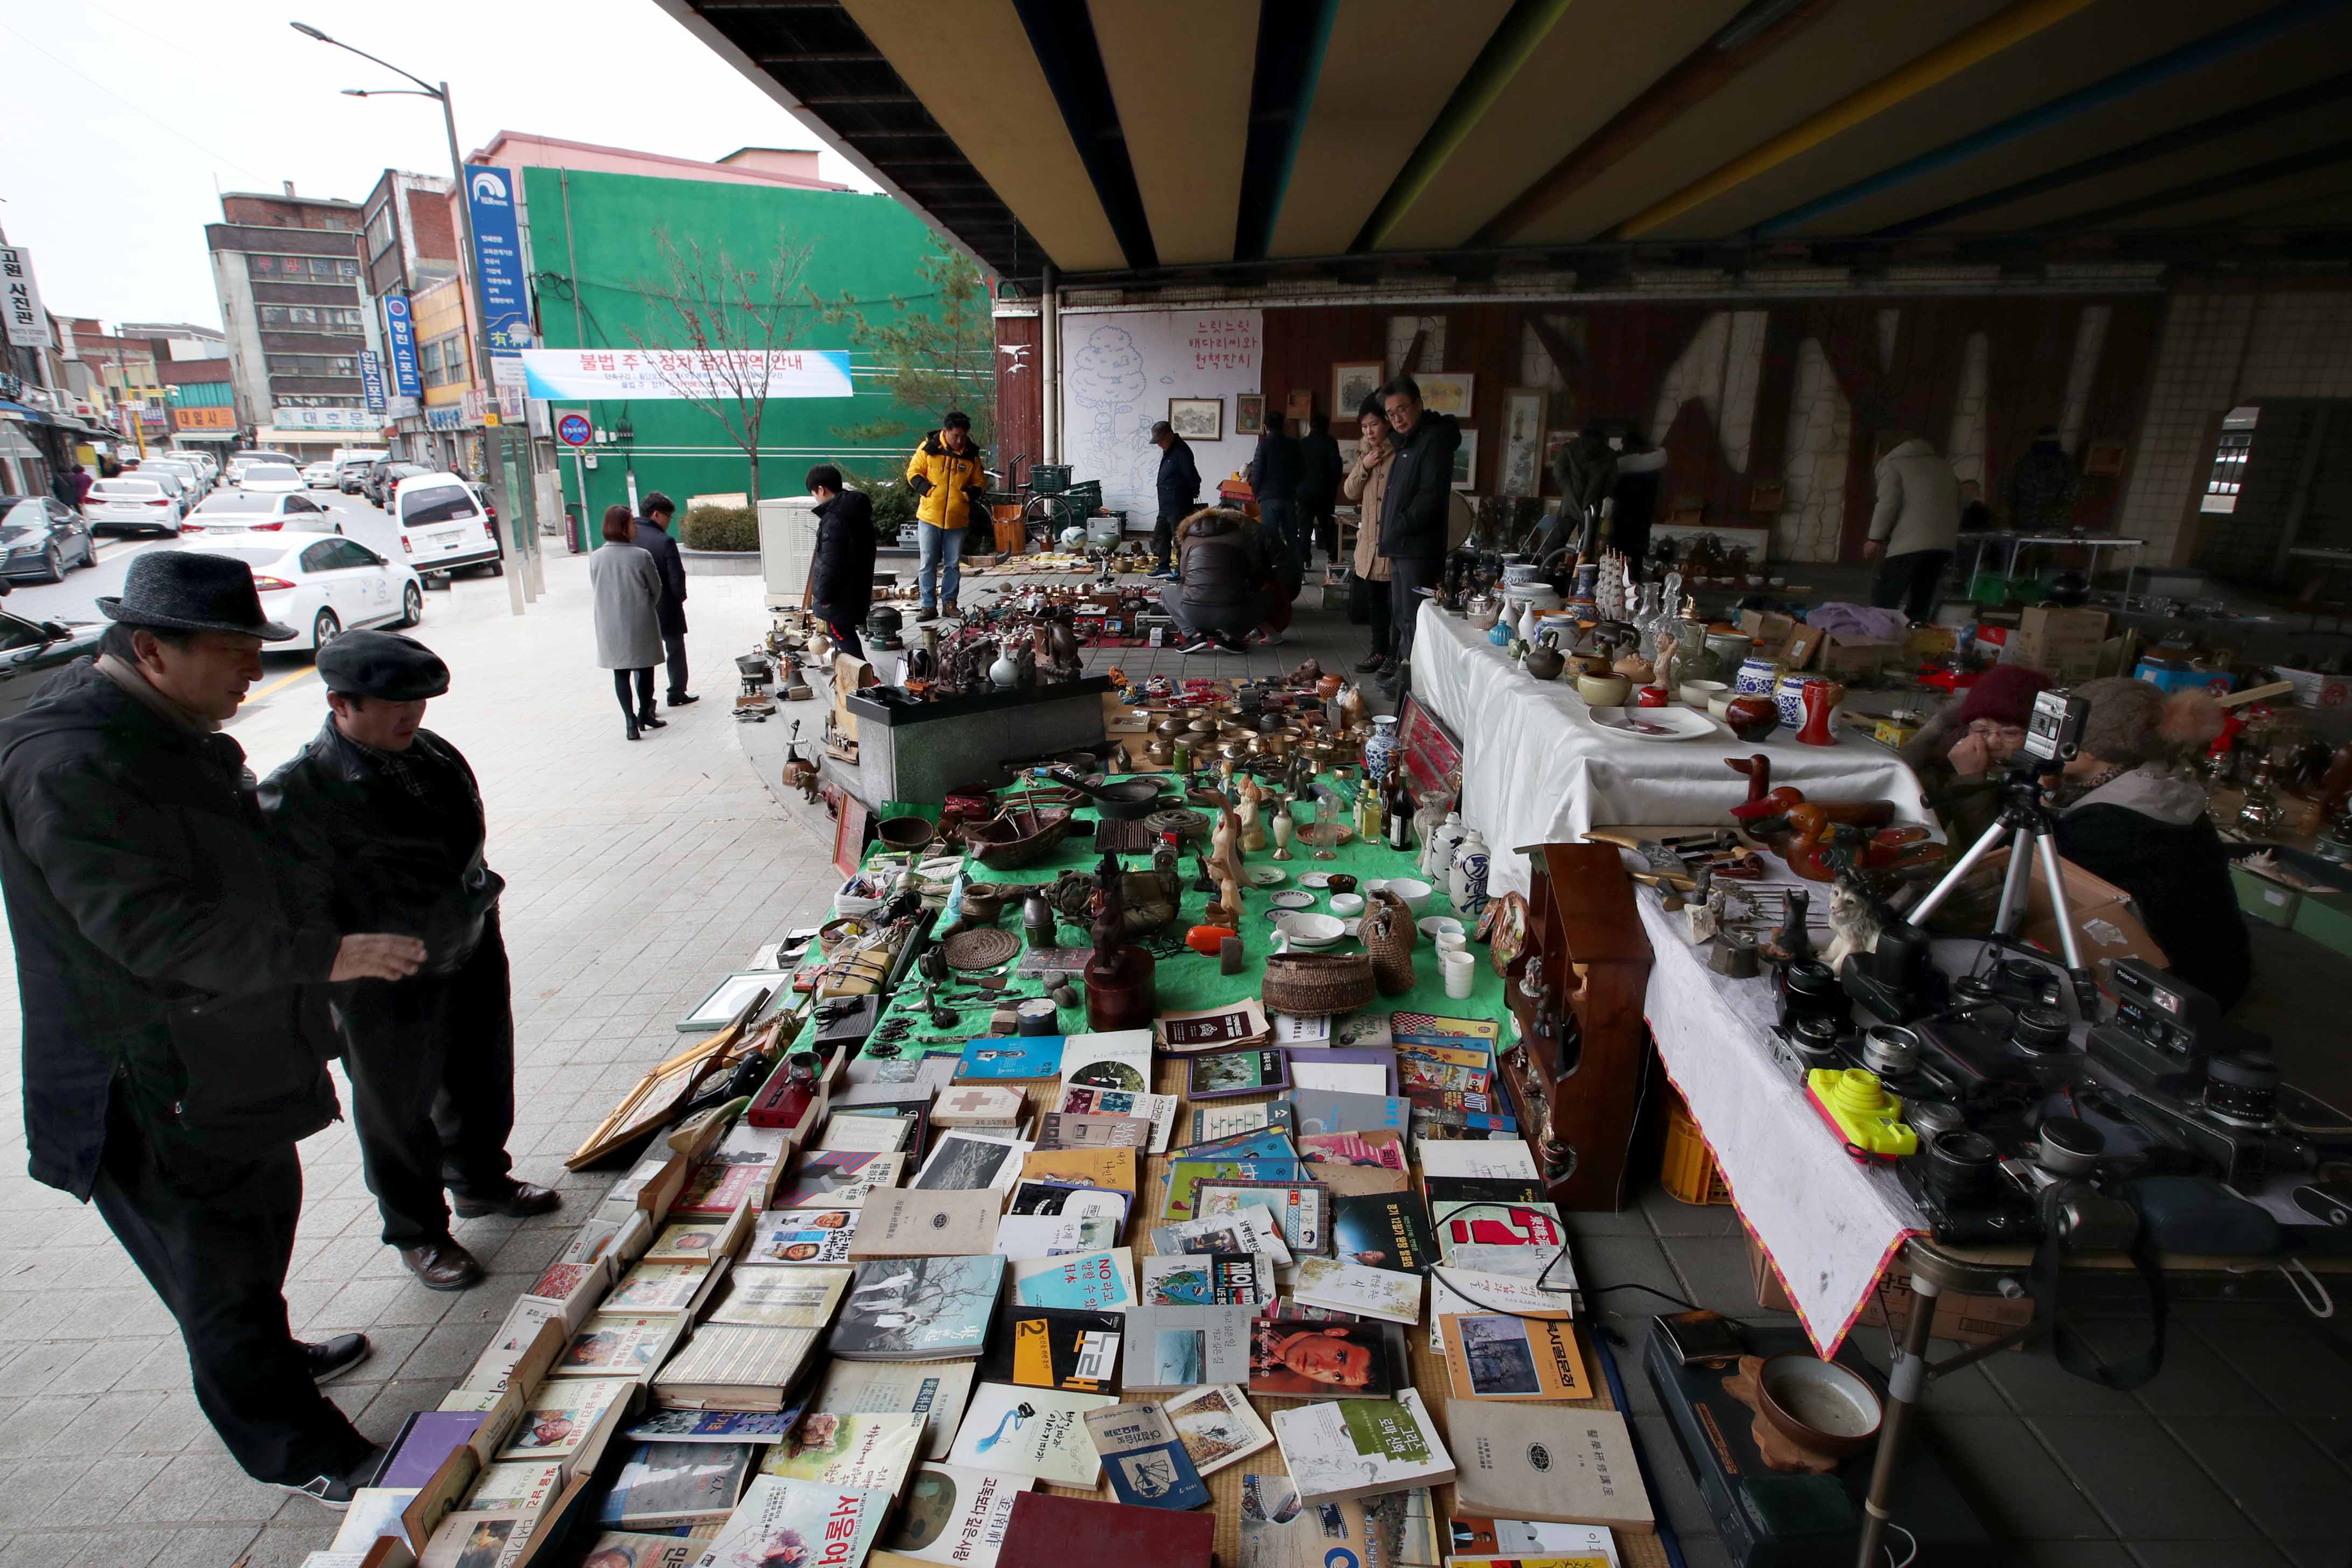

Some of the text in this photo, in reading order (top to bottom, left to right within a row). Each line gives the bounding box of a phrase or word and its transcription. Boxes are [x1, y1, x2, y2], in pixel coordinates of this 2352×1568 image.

[0, 249, 23, 277] 고원
[9, 283, 34, 325] 사진관
[1198, 320, 1249, 333] 느릿느릿
[1189, 336, 1258, 349] 배다리씨와
[398, 349, 415, 384] 스포츠
[580, 354, 802, 371] 불법 주 정차 금지구역 안내
[179, 411, 218, 425] 대일사
[2116, 969, 2138, 985] Polaroid
[1384, 1098, 1401, 1126] art
[1465, 1093, 1487, 1112] NT
[1116, 1152, 1126, 1165] 내가
[869, 1162, 881, 1184] 통하지
[1102, 1161, 1115, 1177] 나인
[1387, 1203, 1399, 1215] 경기
[1062, 1223, 1074, 1240] 관계
[1391, 1217, 1403, 1235] 12잡가
[1395, 1236, 1408, 1249] 완창
[1400, 1249, 1413, 1268] 발표회
[1063, 1263, 1077, 1284] 日本
[1081, 1261, 1095, 1280] 말할
[1098, 1258, 1114, 1301] NO 라고
[1083, 1285, 1096, 1294] 수
[1349, 1279, 1365, 1288] 시
[1470, 1280, 1489, 1292] 예술
[1494, 1282, 1515, 1293] 삶과
[1021, 1321, 1046, 1336] 2
[1100, 1318, 1112, 1326] 7
[1213, 1328, 1224, 1364] 가고 싶은 길
[1224, 1338, 1236, 1347] 일
[580, 1400, 597, 1419] 남긴
[565, 1420, 586, 1447] 사람들
[1124, 1429, 1161, 1444] 아침자습
[1378, 1417, 1406, 1455] 로마 신화
[1398, 1424, 1429, 1453] 그리스
[525, 1467, 557, 1509] 빛을 남긴
[709, 1474, 726, 1495] 女人
[510, 1519, 535, 1538] 다시
[952, 1477, 998, 1562] 고독보다 깊은 사랑
[818, 1495, 859, 1568] 서울여
